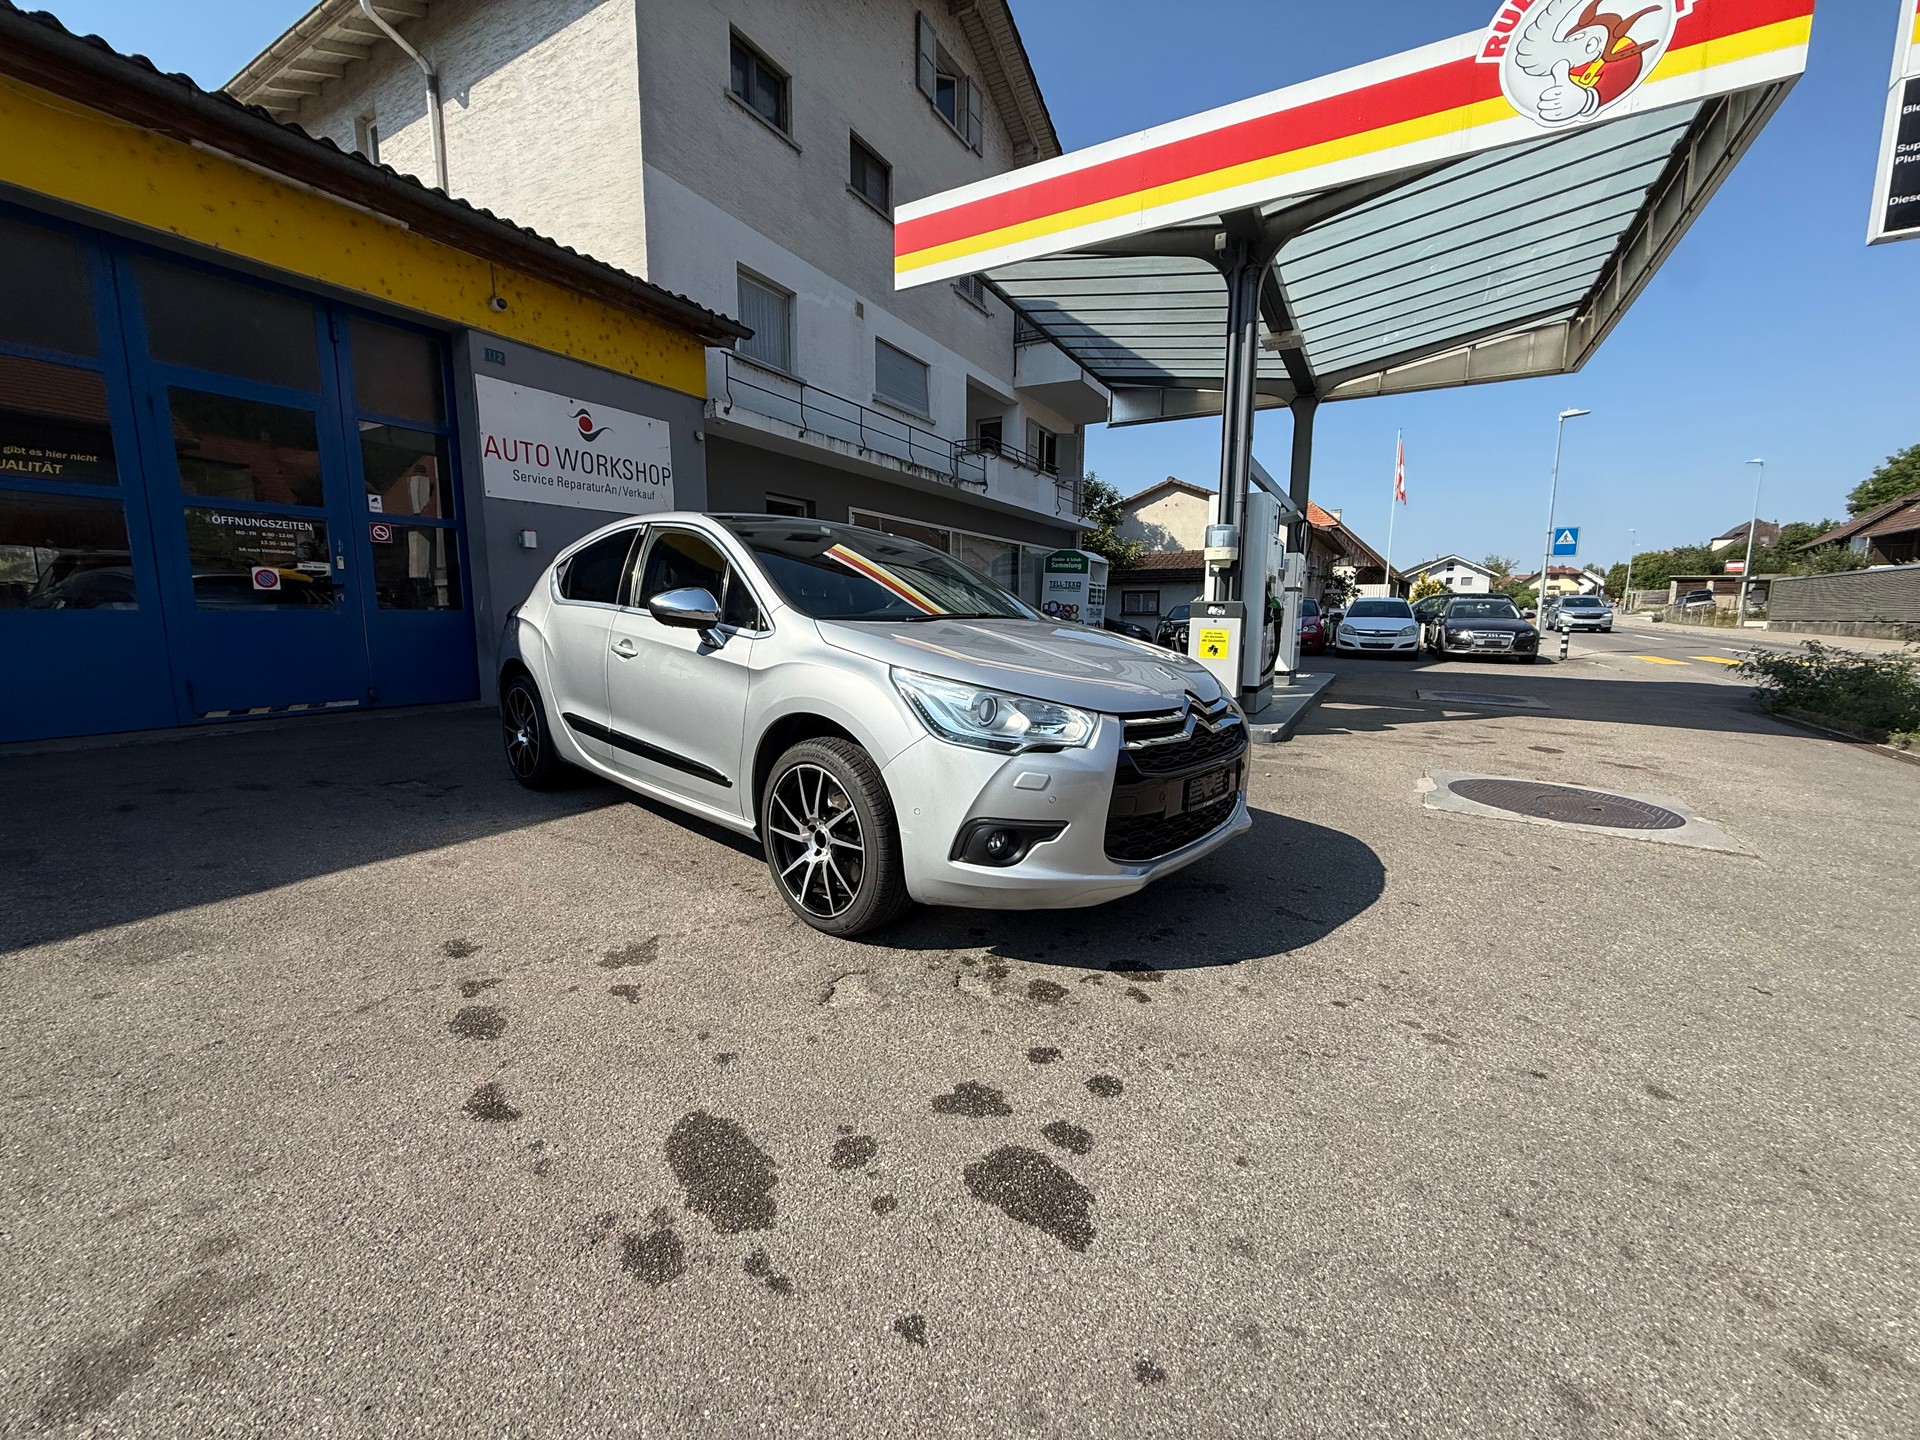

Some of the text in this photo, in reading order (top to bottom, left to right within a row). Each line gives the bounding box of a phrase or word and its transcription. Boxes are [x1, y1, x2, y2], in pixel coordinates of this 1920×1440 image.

[488, 350, 503, 362] 112
[2, 445, 98, 463] gibt es hier nicht
[483, 435, 672, 487] AUTO WORKSHOP
[512, 469, 554, 486] Service
[212, 514, 313, 531] ÖFFNUNGSZEITEN
[1051, 562, 1082, 570] Sammlung
